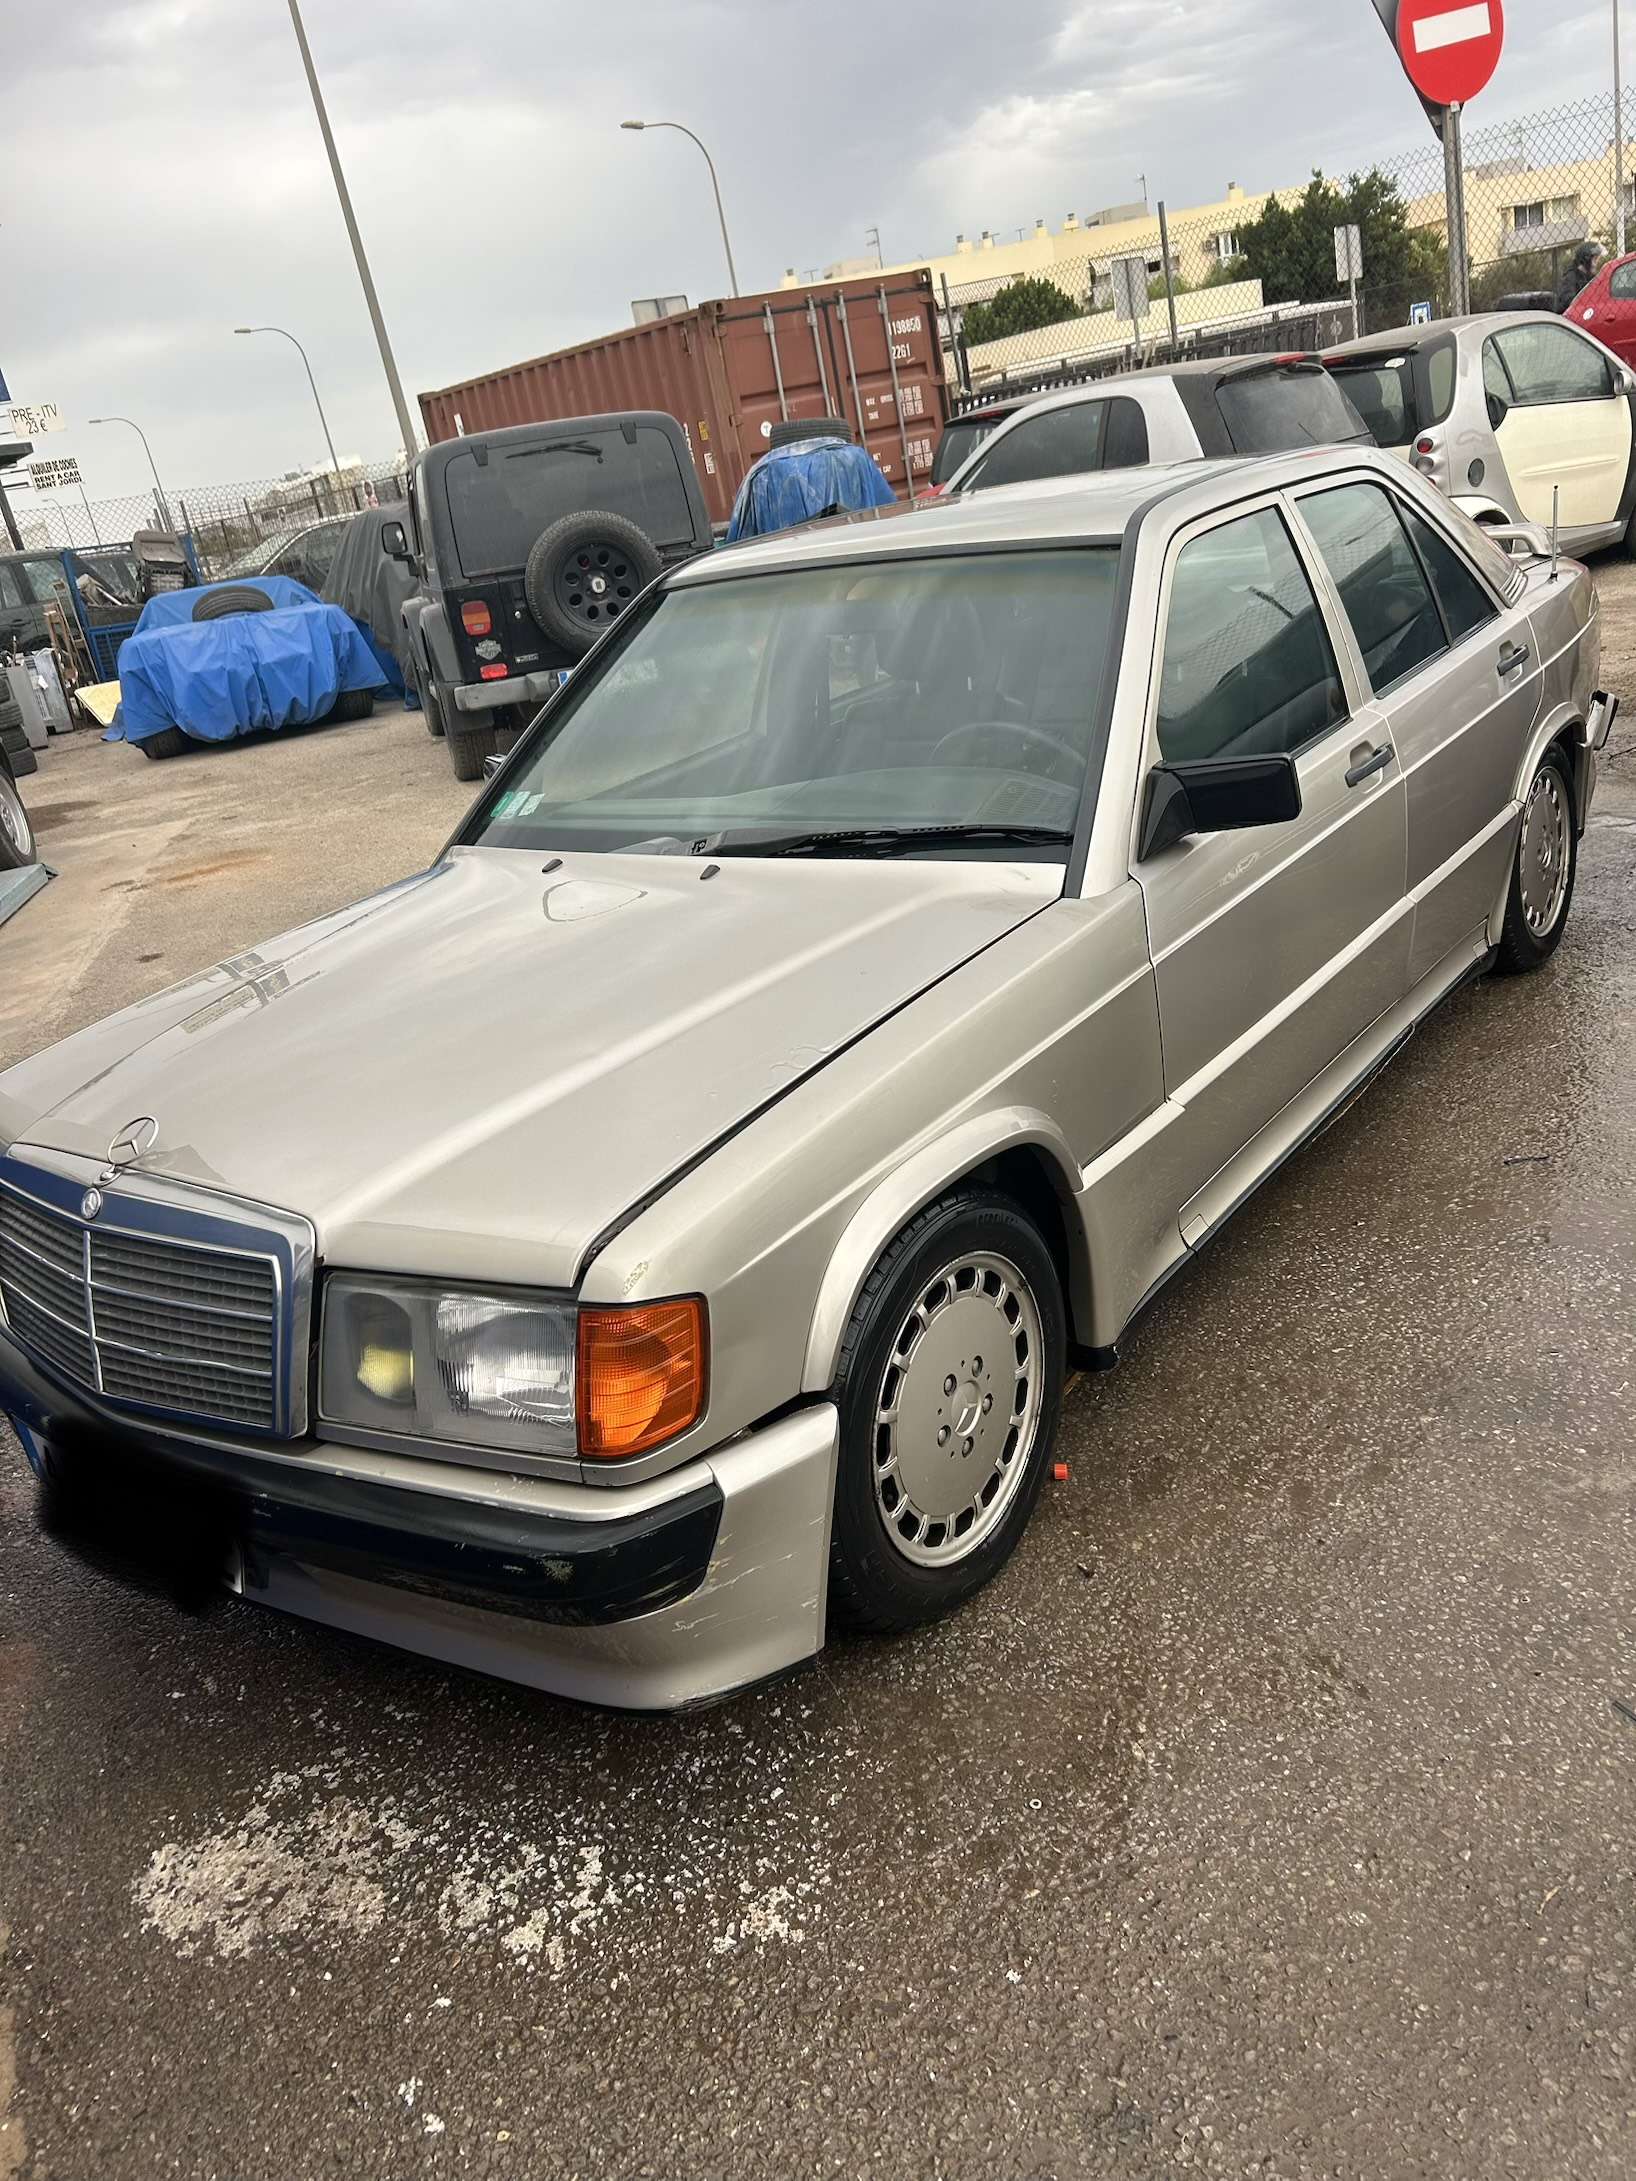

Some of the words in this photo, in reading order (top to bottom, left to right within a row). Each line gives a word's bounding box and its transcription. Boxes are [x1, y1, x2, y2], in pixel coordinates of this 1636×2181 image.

[11, 407, 34, 423] PRE
[41, 402, 57, 418] ITV
[26, 420, 39, 434] 23
[40, 418, 48, 432] €
[34, 474, 55, 483] RENT
[63, 470, 80, 478] CAR
[36, 481, 57, 490] SANT
[58, 476, 82, 486] JORDI
